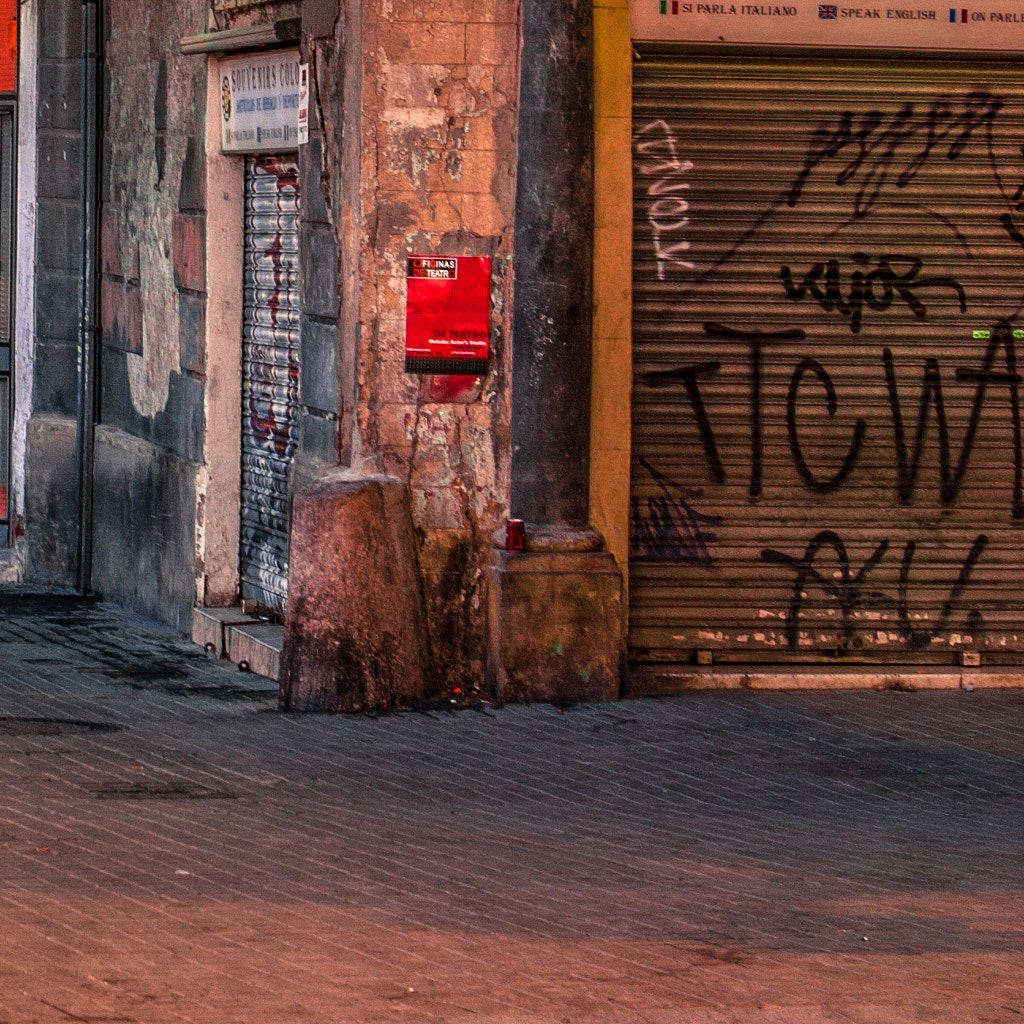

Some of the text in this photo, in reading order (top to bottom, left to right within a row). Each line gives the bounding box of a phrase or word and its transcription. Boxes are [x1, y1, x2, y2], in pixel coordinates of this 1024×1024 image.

[681, 3, 798, 17] SI PARLA ITALIANO
[840, 7, 937, 20] SPEAK ENGLISH
[971, 11, 986, 22] ON
[231, 64, 277, 93] SOUVENIRS
